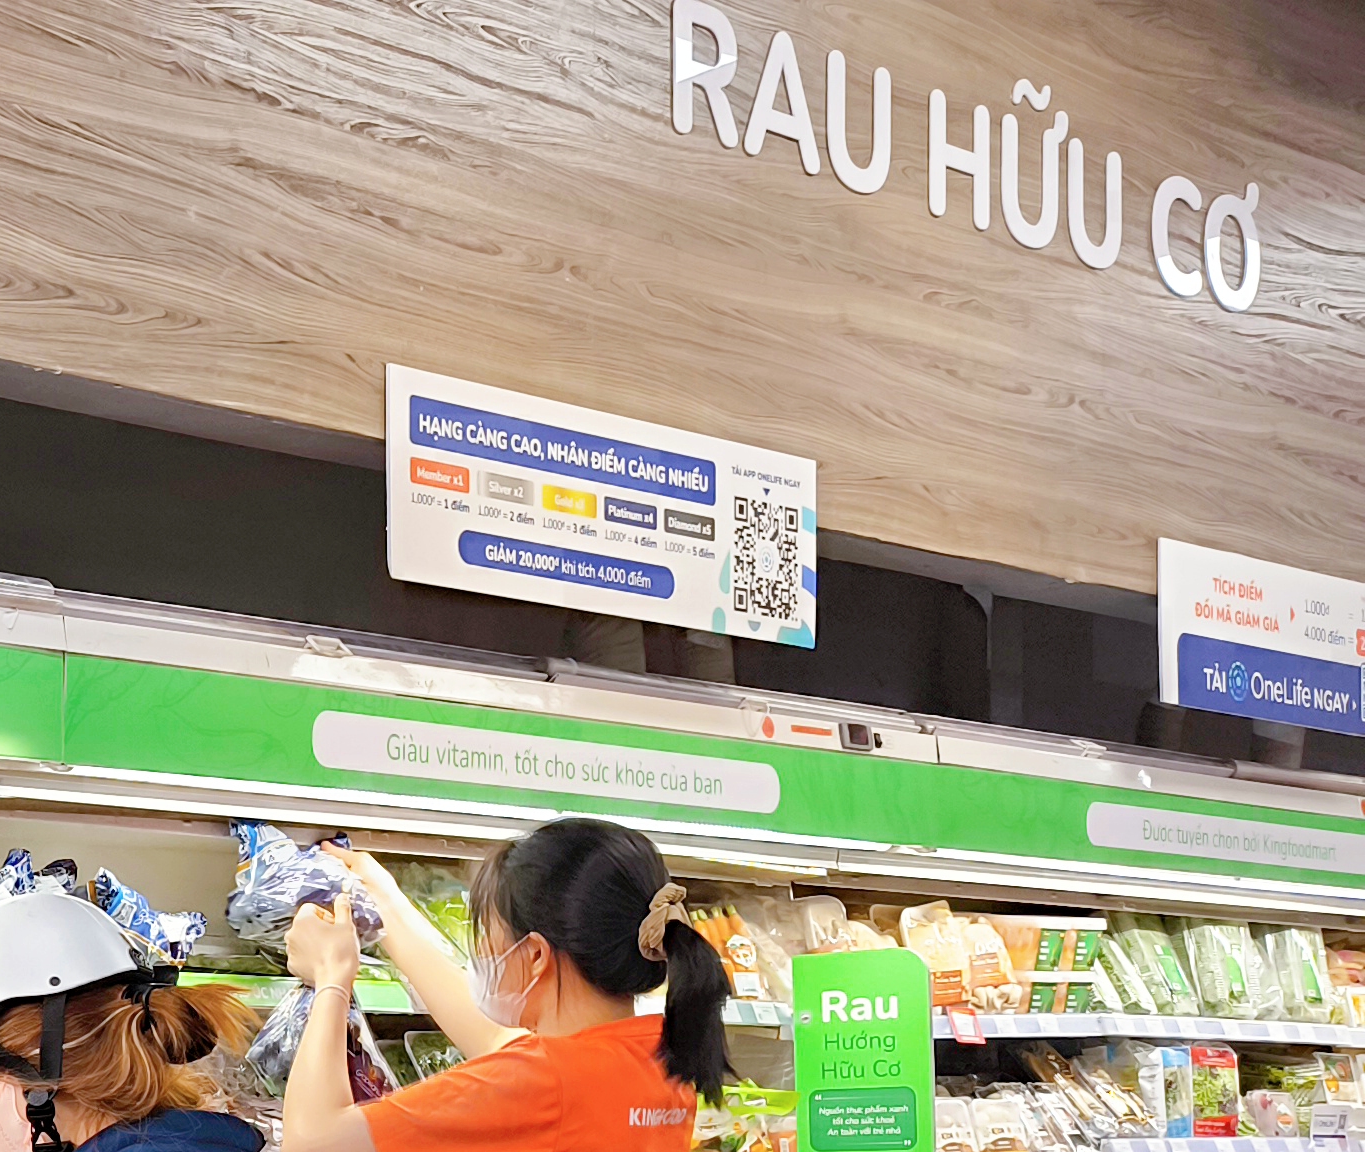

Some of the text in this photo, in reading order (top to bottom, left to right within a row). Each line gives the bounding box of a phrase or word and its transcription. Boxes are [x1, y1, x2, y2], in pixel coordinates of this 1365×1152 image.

[672, 2, 1261, 313] RAU HỮU CƠ
[419, 413, 709, 493] HẠNG CÀNG CAO, NHÂN ĐIỂM CÀNG NHIỀU
[485, 542, 517, 566] GIẢM
[561, 558, 576, 574] khi
[577, 563, 596, 580] tích
[598, 566, 626, 586] 4,000
[628, 571, 651, 589] điểm
[1212, 575, 1263, 601] TÍCH ĐIỂM
[1216, 605, 1232, 623] MÃ
[1235, 611, 1260, 629] GIẢM
[1203, 661, 1349, 713] TẢI OneLife NGAY
[386, 733, 724, 797] Giàu vitamin, tốt cho sức khỏe của bạn
[1142, 819, 1173, 843] Được
[1263, 834, 1337, 862] Kingfoodmart
[821, 990, 899, 1023] Rau
[825, 1031, 896, 1052] Hướng
[821, 1060, 901, 1080] Hữu Cơ
